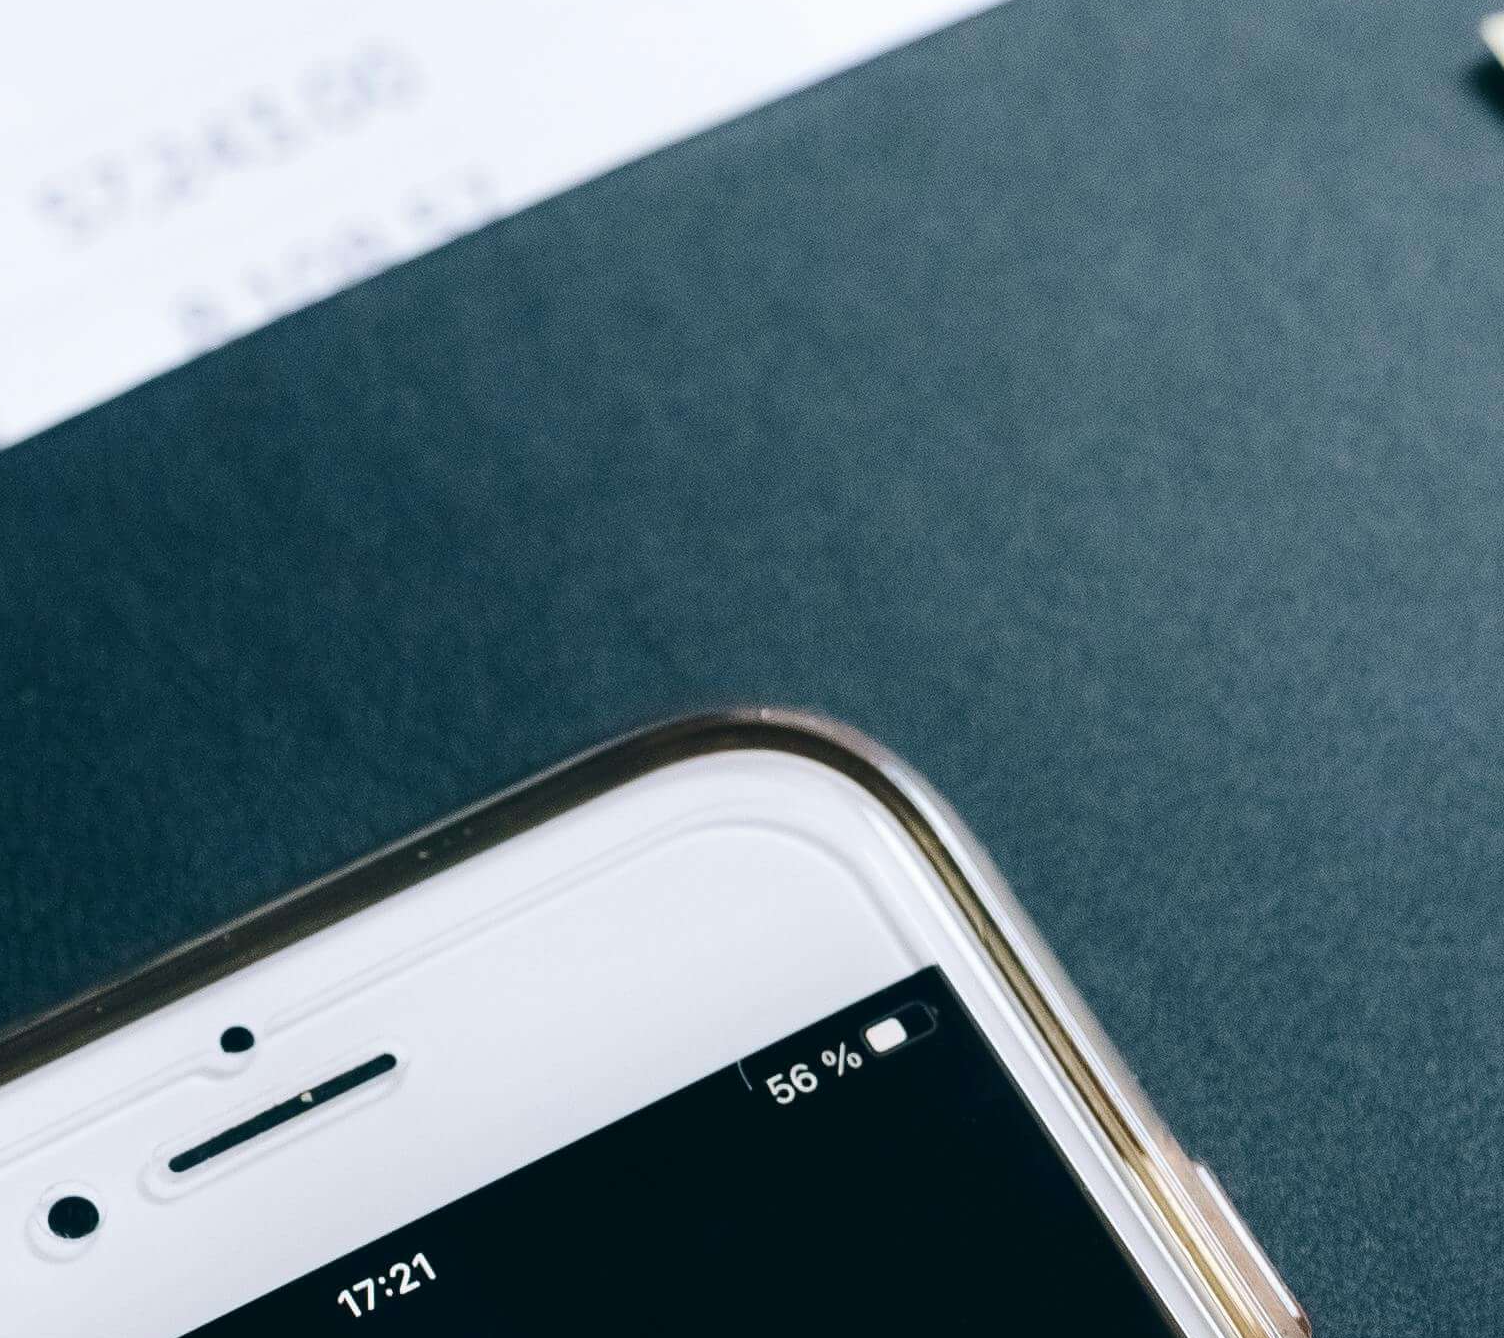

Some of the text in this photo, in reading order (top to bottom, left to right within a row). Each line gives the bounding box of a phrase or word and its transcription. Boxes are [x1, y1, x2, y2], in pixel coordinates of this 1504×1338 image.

[763, 1040, 866, 1107] 56 %
[335, 1250, 439, 1320] 17:21
